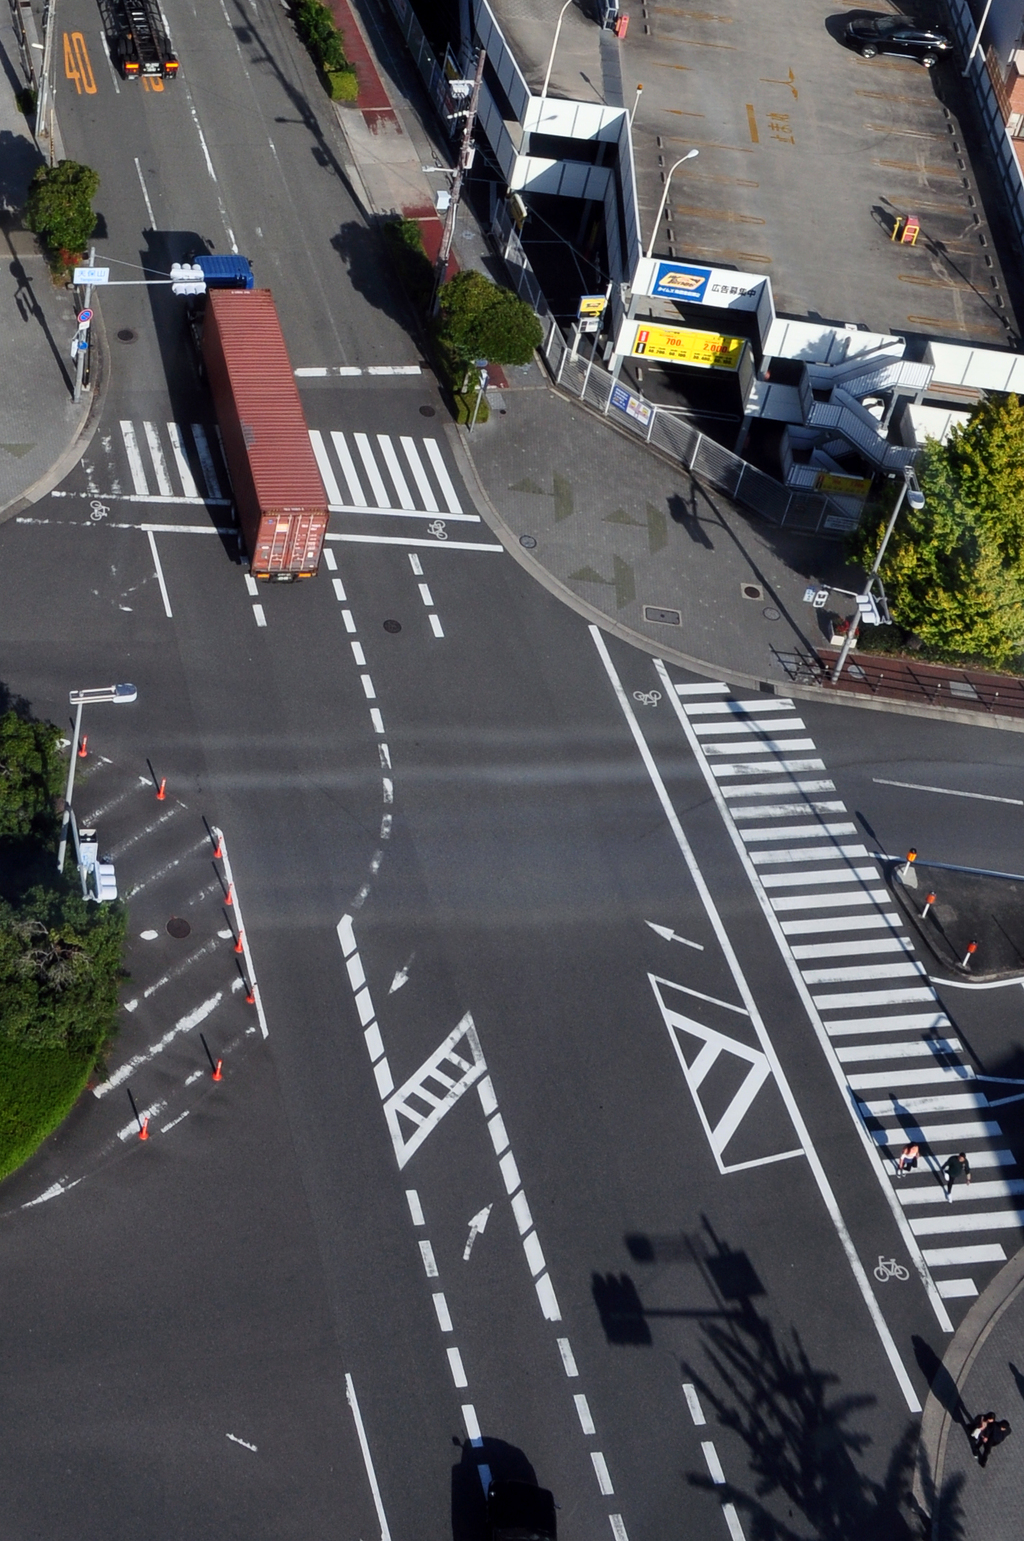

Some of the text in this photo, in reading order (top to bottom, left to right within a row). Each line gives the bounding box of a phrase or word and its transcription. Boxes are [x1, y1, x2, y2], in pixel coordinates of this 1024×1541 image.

[62, 31, 98, 95] 40
[711, 283, 757, 298] 広告募集中
[666, 338, 682, 347] 700
